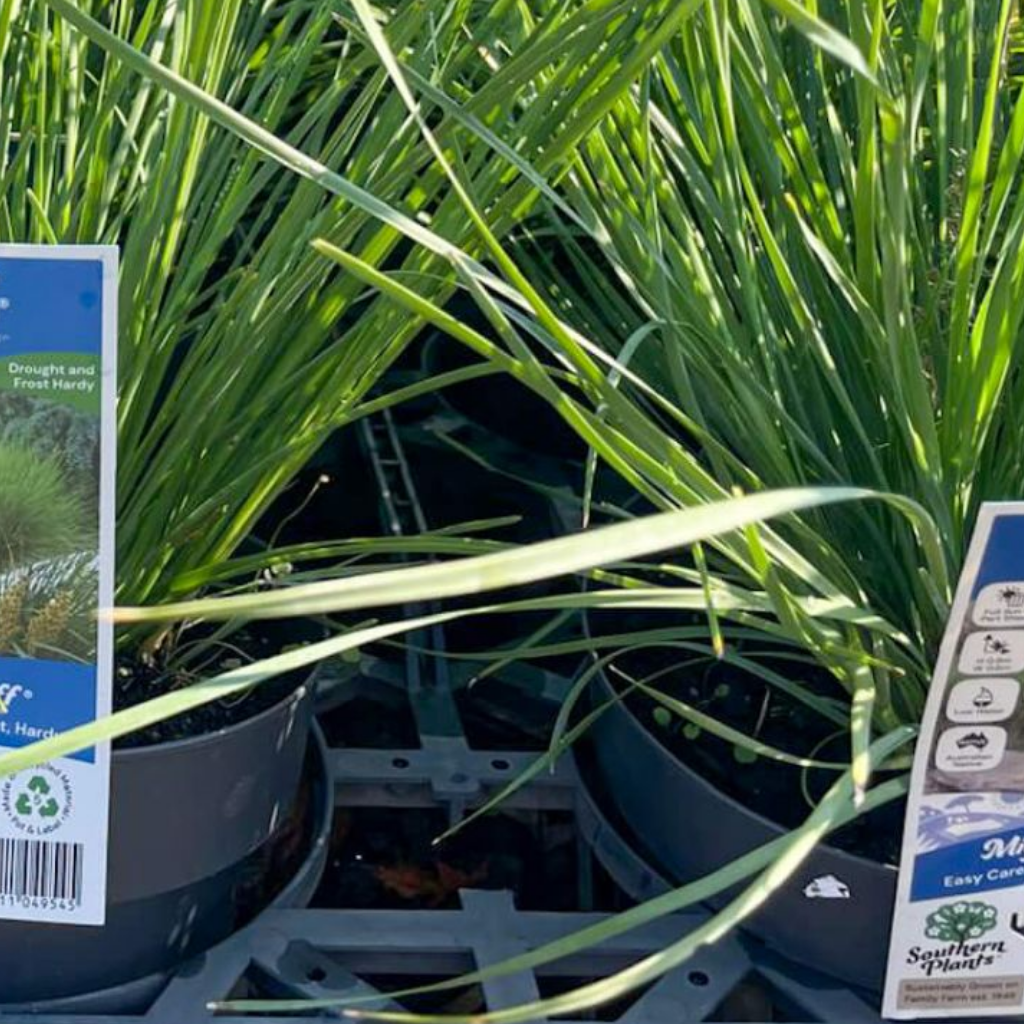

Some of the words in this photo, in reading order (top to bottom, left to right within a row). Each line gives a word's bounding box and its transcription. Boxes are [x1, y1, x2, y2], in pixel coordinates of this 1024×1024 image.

[8, 362, 65, 378] Drought
[68, 364, 95, 375] and
[13, 377, 49, 390] Frost
[52, 378, 96, 393] Hardy
[15, 721, 60, 740] Hard
[944, 873, 983, 888] Easy
[906, 941, 1007, 965] Southern
[920, 954, 994, 977] Plants
